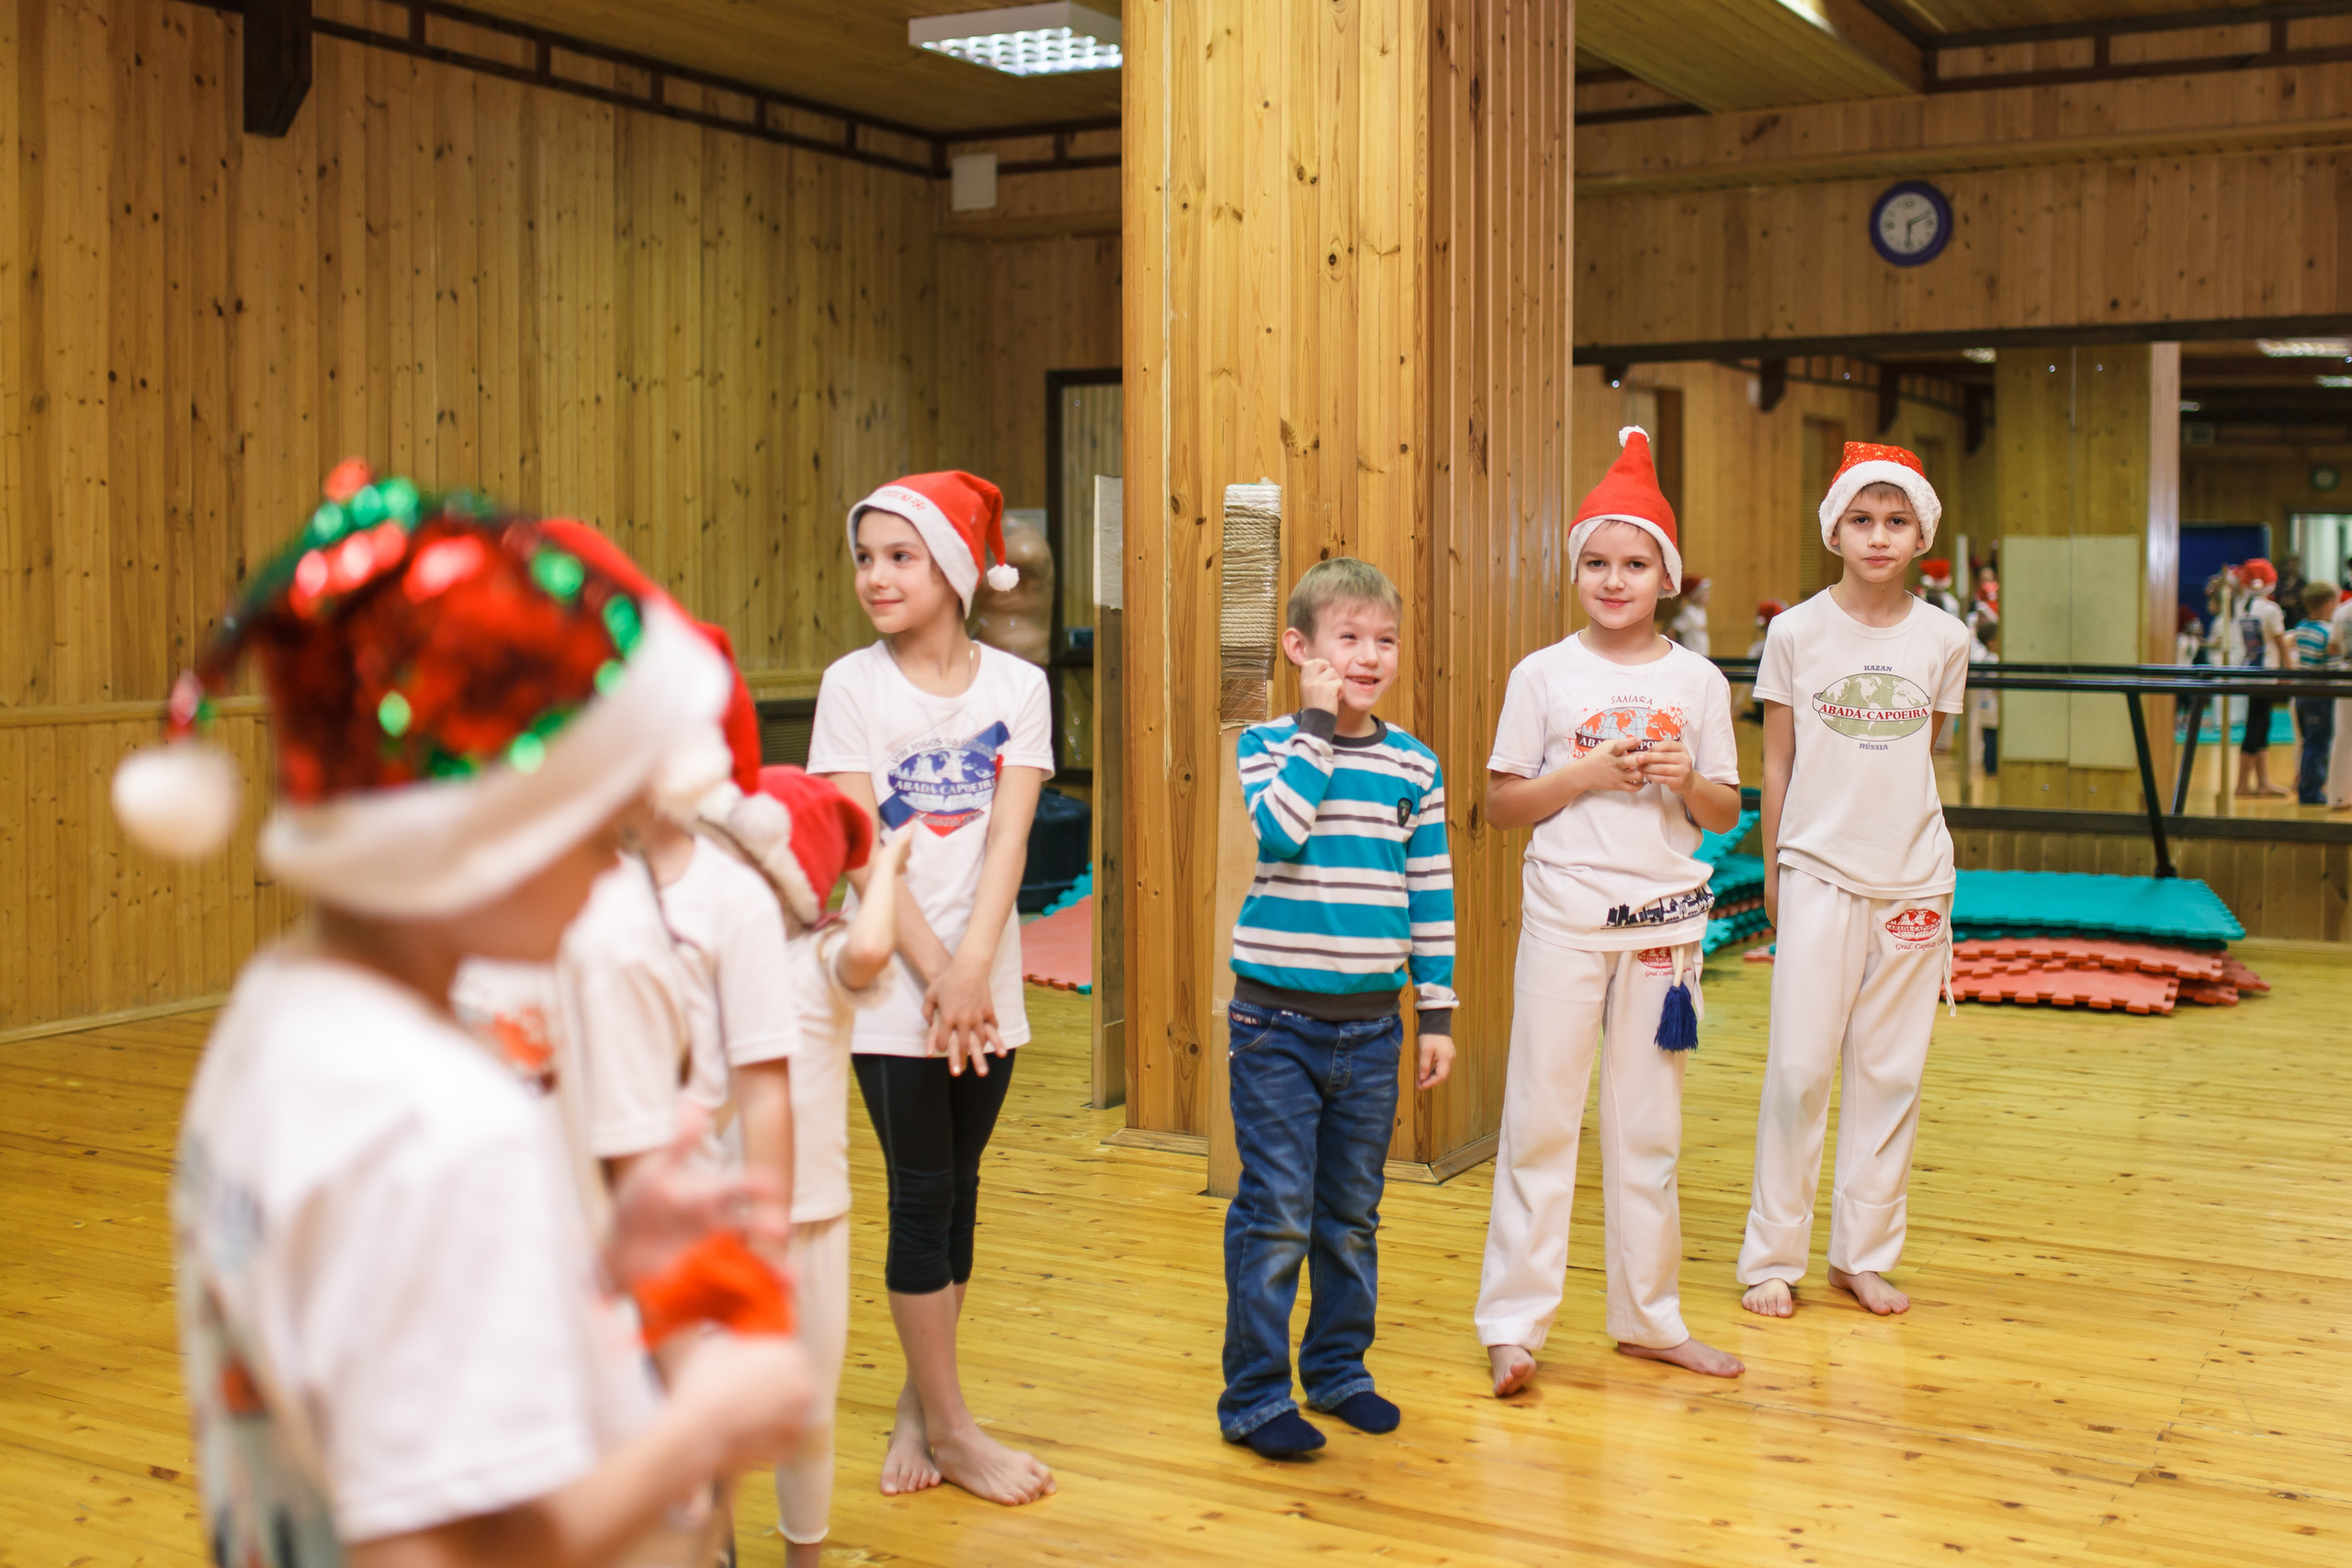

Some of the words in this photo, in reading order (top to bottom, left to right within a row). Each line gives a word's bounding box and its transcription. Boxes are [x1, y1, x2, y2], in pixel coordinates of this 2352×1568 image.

[1611, 695, 1653, 705] SAMARA
[1819, 704, 1928, 720] ABADÁ-CAPOEIRA
[1859, 742, 1889, 750] RÚSSIA
